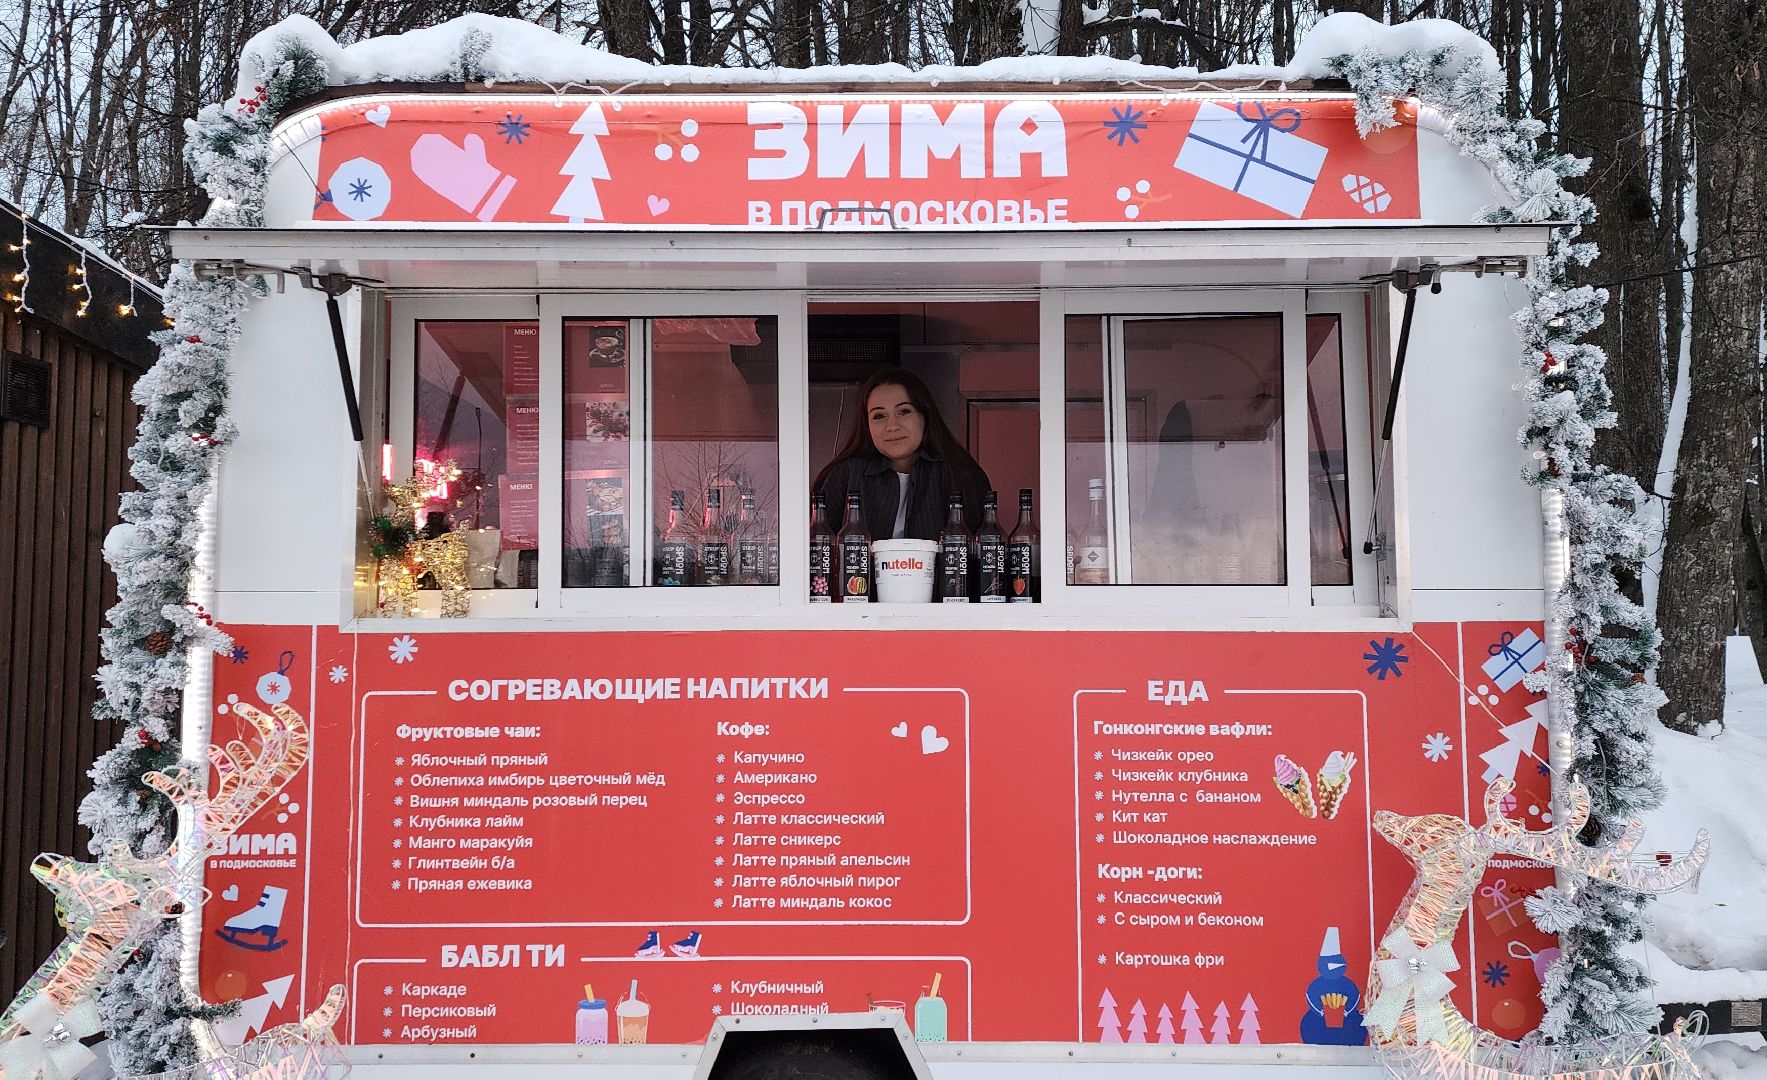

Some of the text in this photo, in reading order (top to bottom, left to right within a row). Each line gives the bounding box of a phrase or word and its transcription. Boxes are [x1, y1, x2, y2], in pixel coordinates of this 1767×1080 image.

[747, 100, 1069, 180] ЗИМА
[748, 198, 1069, 226] В ПОДМОСКОВЬЕ
[514, 328, 537, 336] МЕНЮ
[516, 406, 539, 414] МЕНЮ
[509, 483, 533, 491] МЕНЮ
[822, 545, 831, 574] SPOOM
[860, 545, 868, 574] SPOOM
[881, 557, 924, 570] nutella
[959, 546, 968, 575] SPOOM
[997, 545, 1005, 573] SPOOM
[1021, 546, 1030, 575] SPOOM
[448, 677, 829, 704] СОГРЕВАЮЩИЕ НАПИТКИ
[1147, 679, 1210, 706] ЕДА
[395, 723, 541, 742] Фруктовые чаи:
[716, 721, 770, 739] Кофе:
[1093, 720, 1273, 739] Гонконгские вафли:
[411, 752, 548, 769] Яблочный пряный
[734, 750, 805, 767] Капучино
[1111, 748, 1214, 764] Чизкейк орео
[410, 771, 666, 789] Облепиха имбирь цветочный мёд
[733, 770, 818, 786] Американо
[1111, 768, 1249, 785] Чизкейк клубника
[409, 793, 648, 810] Вишня миндаль розовый перец
[733, 791, 806, 808] Эспрессо
[1111, 789, 1262, 805] Нутелла с бананом
[409, 814, 524, 832] Клубника лайм
[732, 811, 885, 825] Латте классический
[1112, 809, 1168, 823] Кит кат
[408, 835, 533, 852] Манго маракуйя
[732, 832, 842, 849] Латте сникерс
[1112, 830, 1317, 847] Шоколадное наслаждение
[219, 859, 297, 869] ПОДМОСКОВЬЕ
[408, 855, 515, 871] Глинтвейн б/а
[732, 852, 911, 870] Латте пряный апельсин
[1487, 859, 1553, 869] ПОДМОСКОВ
[407, 877, 533, 894] Пряная ежевика
[731, 873, 901, 891] Латте яблочный пирог
[731, 894, 892, 911] Латте миндаль кокос
[1113, 890, 1223, 905] Классический
[1114, 911, 1264, 929] С сыром и беконом
[441, 943, 565, 968] БАБЛ ТИ
[1115, 951, 1225, 969] Картошка фри
[401, 982, 467, 999] Каркаде
[730, 980, 824, 998] Клубничный
[401, 1003, 497, 1020] Персиковый
[730, 1001, 829, 1016] Шоколадный
[400, 1024, 477, 1041] Арбузный
